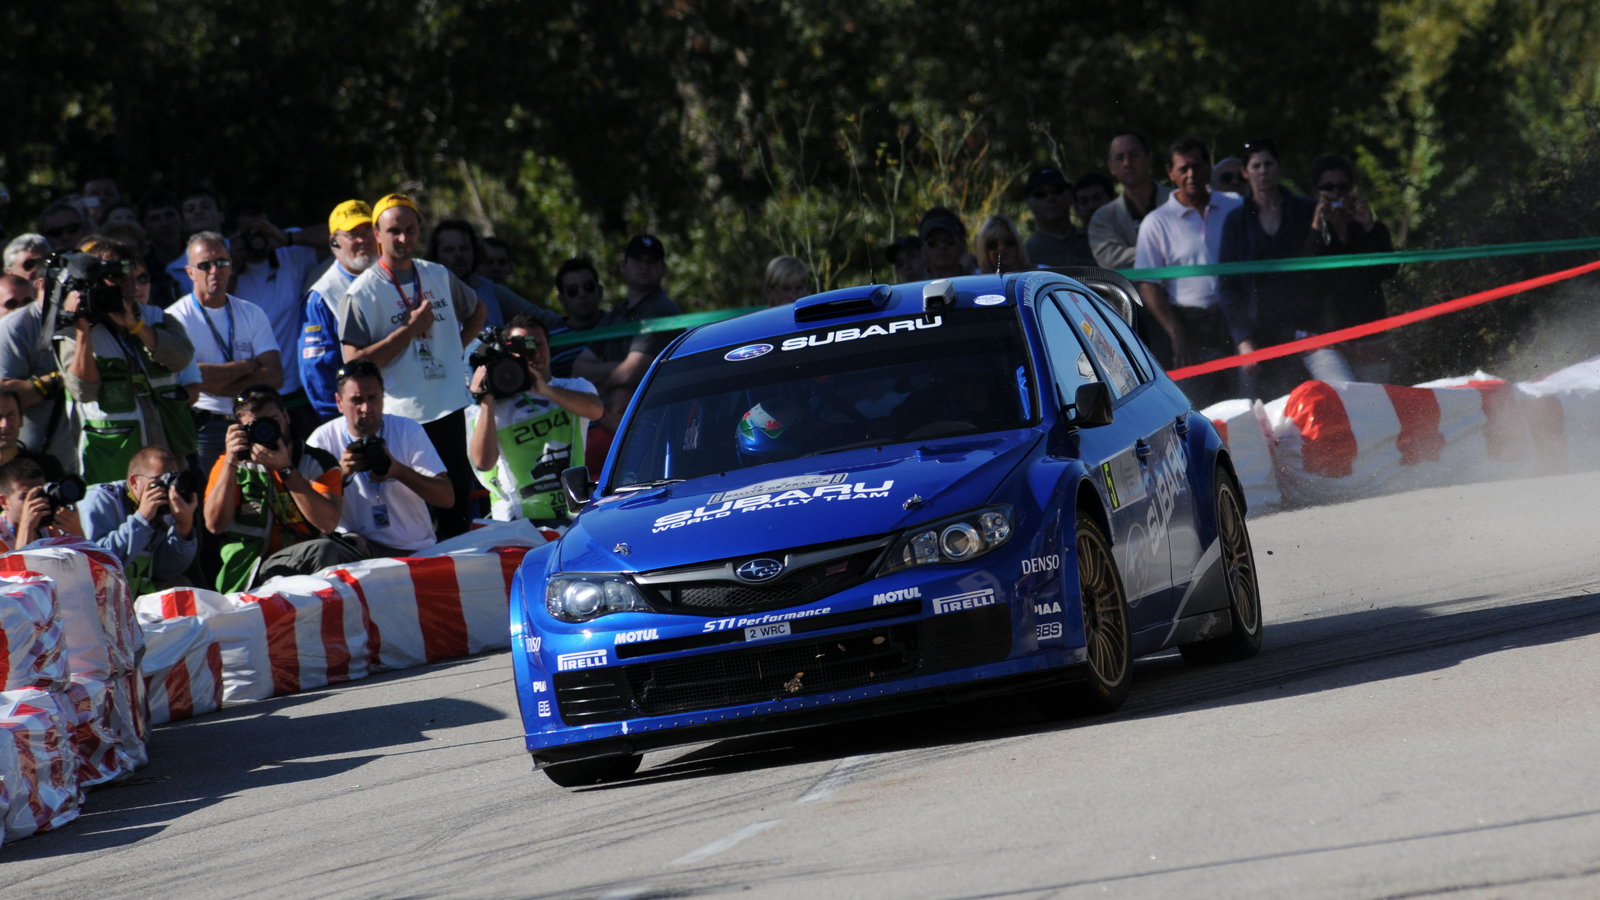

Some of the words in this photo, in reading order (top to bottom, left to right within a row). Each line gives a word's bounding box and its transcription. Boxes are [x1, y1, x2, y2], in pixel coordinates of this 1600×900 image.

[781, 315, 943, 352] SUBARU
[513, 411, 570, 446] 204
[650, 511, 730, 534] WORLD
[741, 498, 814, 514] RALLY
[826, 490, 889, 502] TEAM
[654, 480, 895, 528] SUBARU
[1022, 554, 1060, 575] DENSO
[872, 586, 922, 606] MOTUL
[931, 588, 996, 615] PIRELLI
[702, 617, 737, 633] STI
[736, 606, 832, 627] Performance
[749, 629, 758, 639] 2
[760, 624, 786, 637] WRC
[614, 628, 660, 645] MOTUL
[557, 649, 608, 672] PIRELLI
